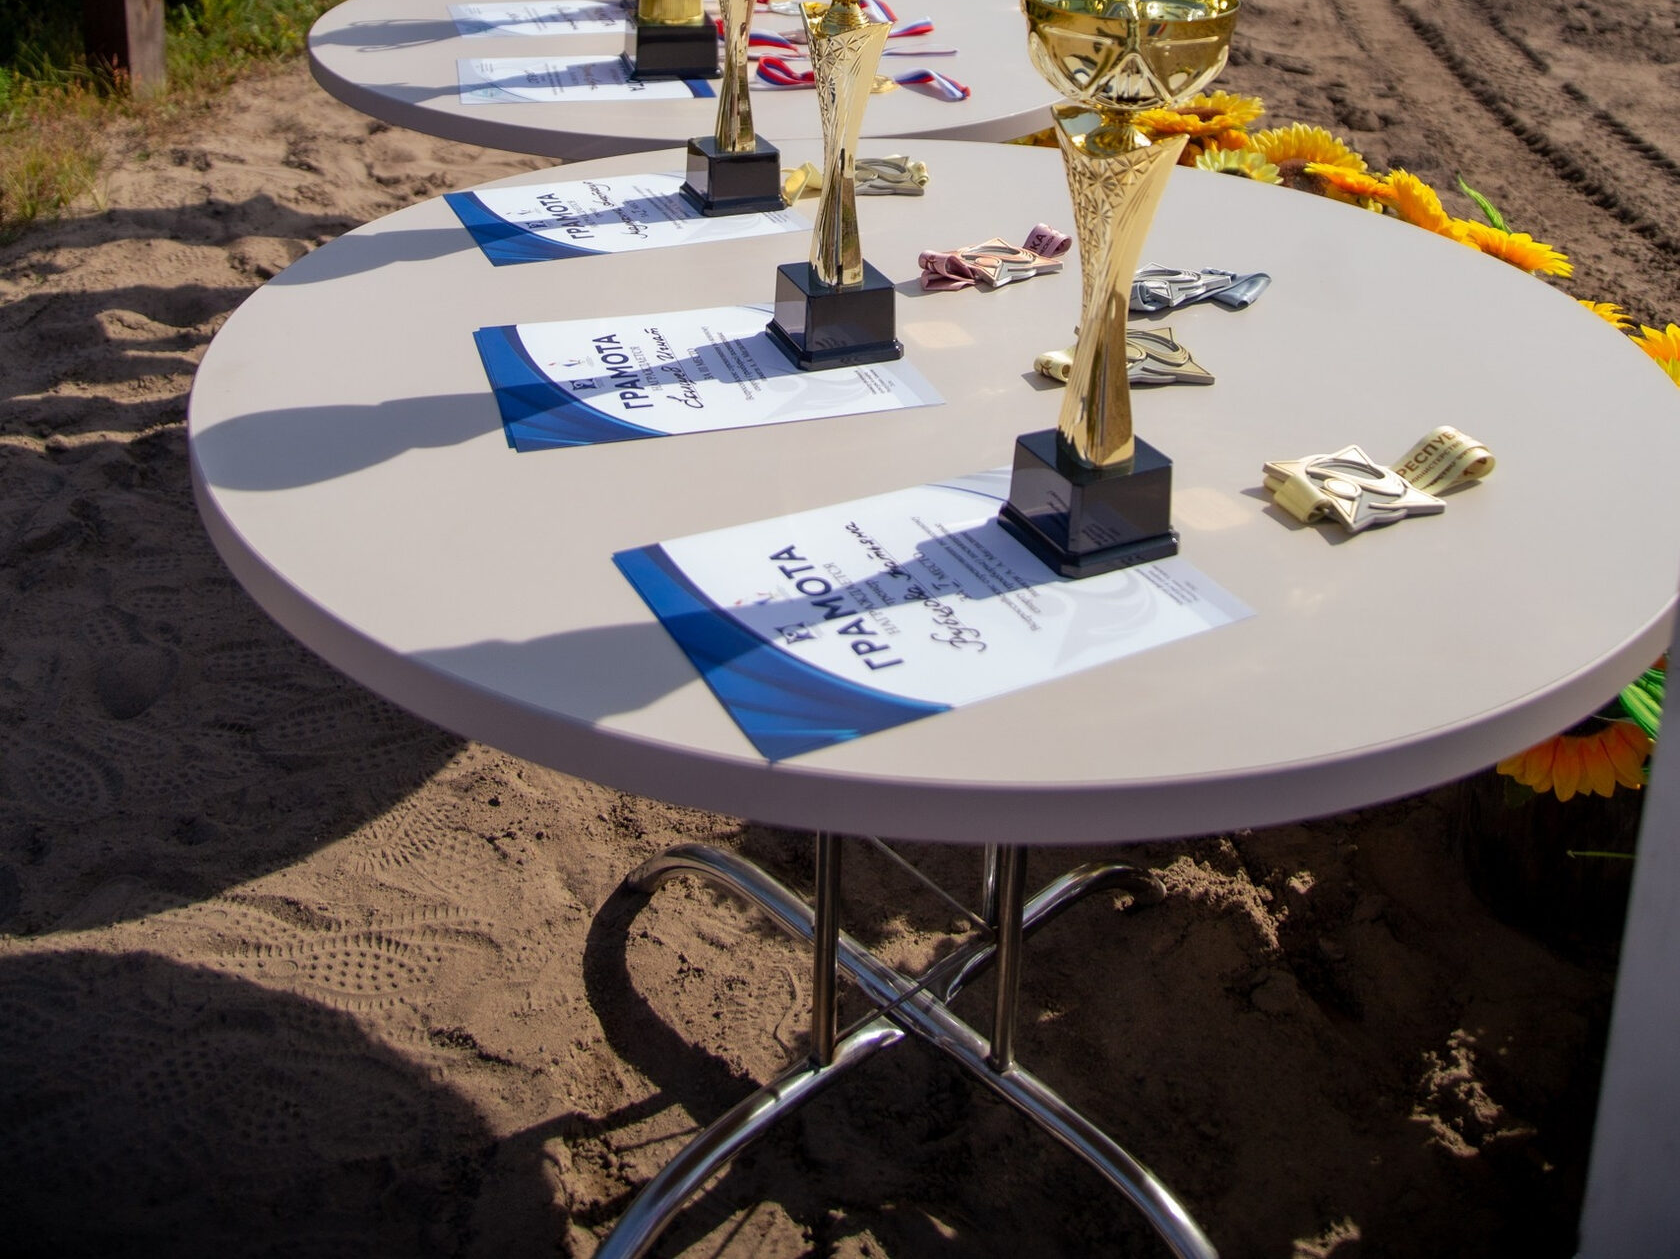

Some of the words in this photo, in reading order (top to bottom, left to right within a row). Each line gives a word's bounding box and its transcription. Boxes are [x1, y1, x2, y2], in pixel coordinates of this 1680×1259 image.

[536, 193, 595, 239] ГРАМОТА
[592, 334, 654, 409] ГРАМОТА
[769, 544, 904, 670] ГРАМОТА
[823, 562, 901, 636] НАГРАЖДАЕТСЯ
